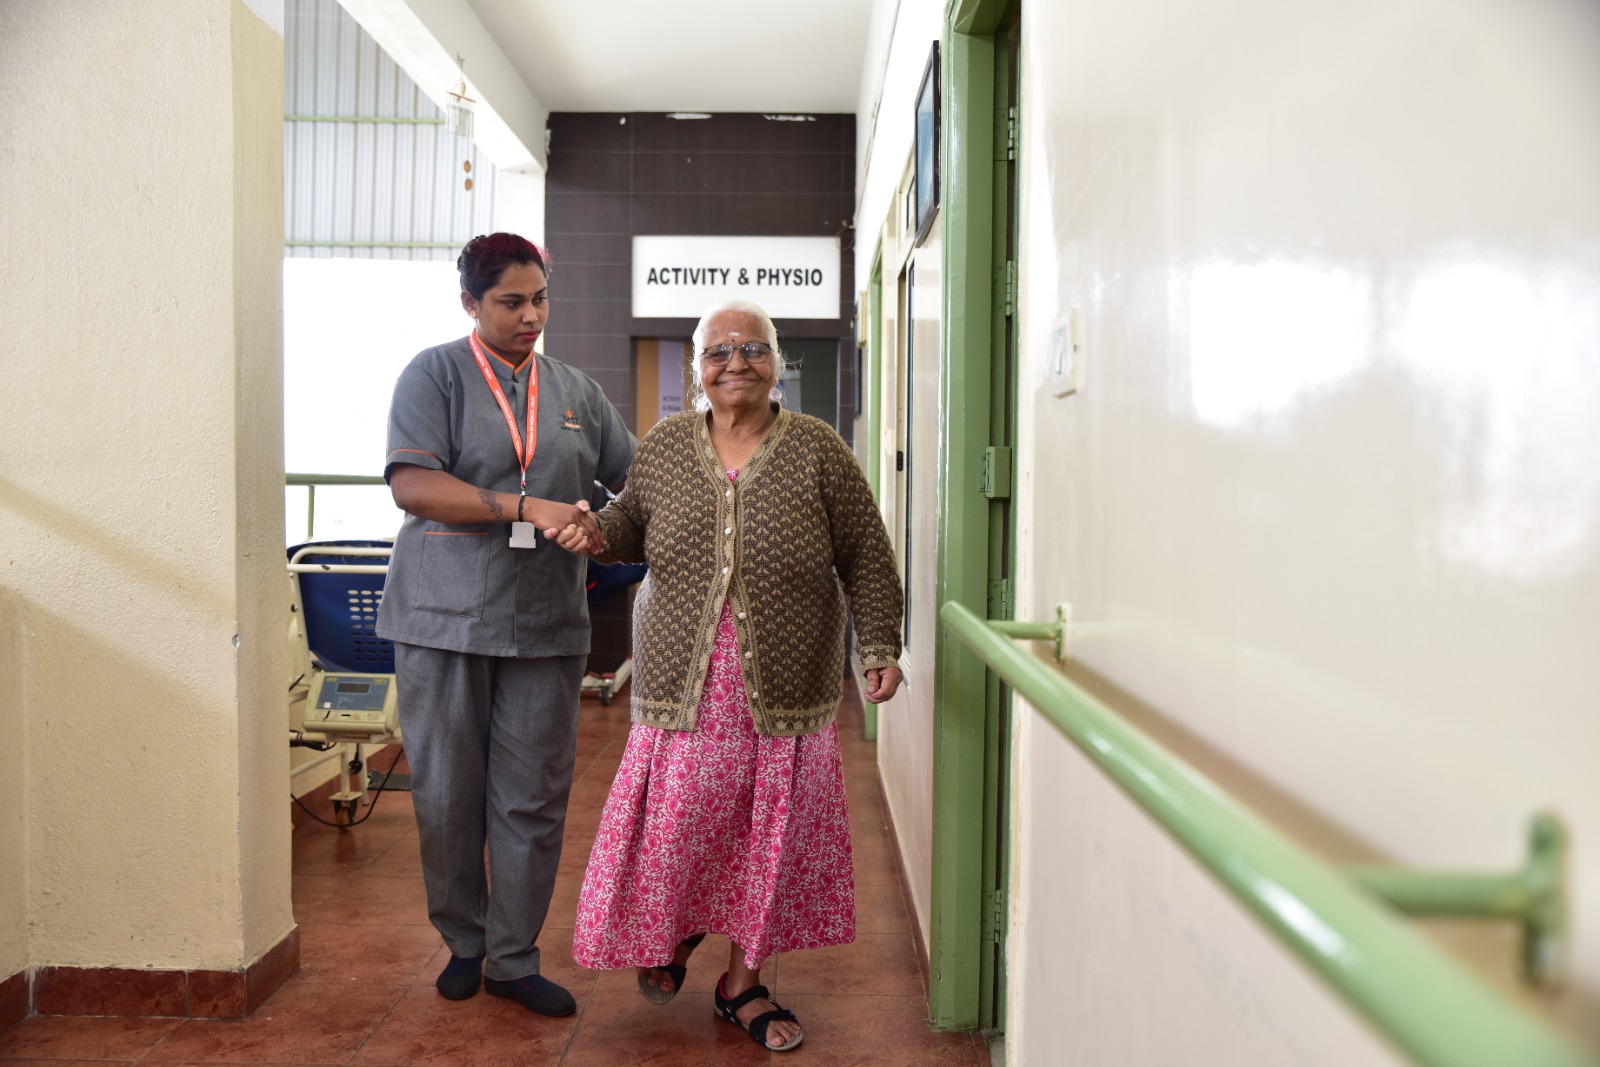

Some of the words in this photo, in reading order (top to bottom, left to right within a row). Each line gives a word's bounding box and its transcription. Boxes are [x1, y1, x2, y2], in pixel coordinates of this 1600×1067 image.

[647, 268, 730, 285] ACTIVITY
[738, 268, 750, 286] &
[757, 268, 823, 286] PHYSIO
